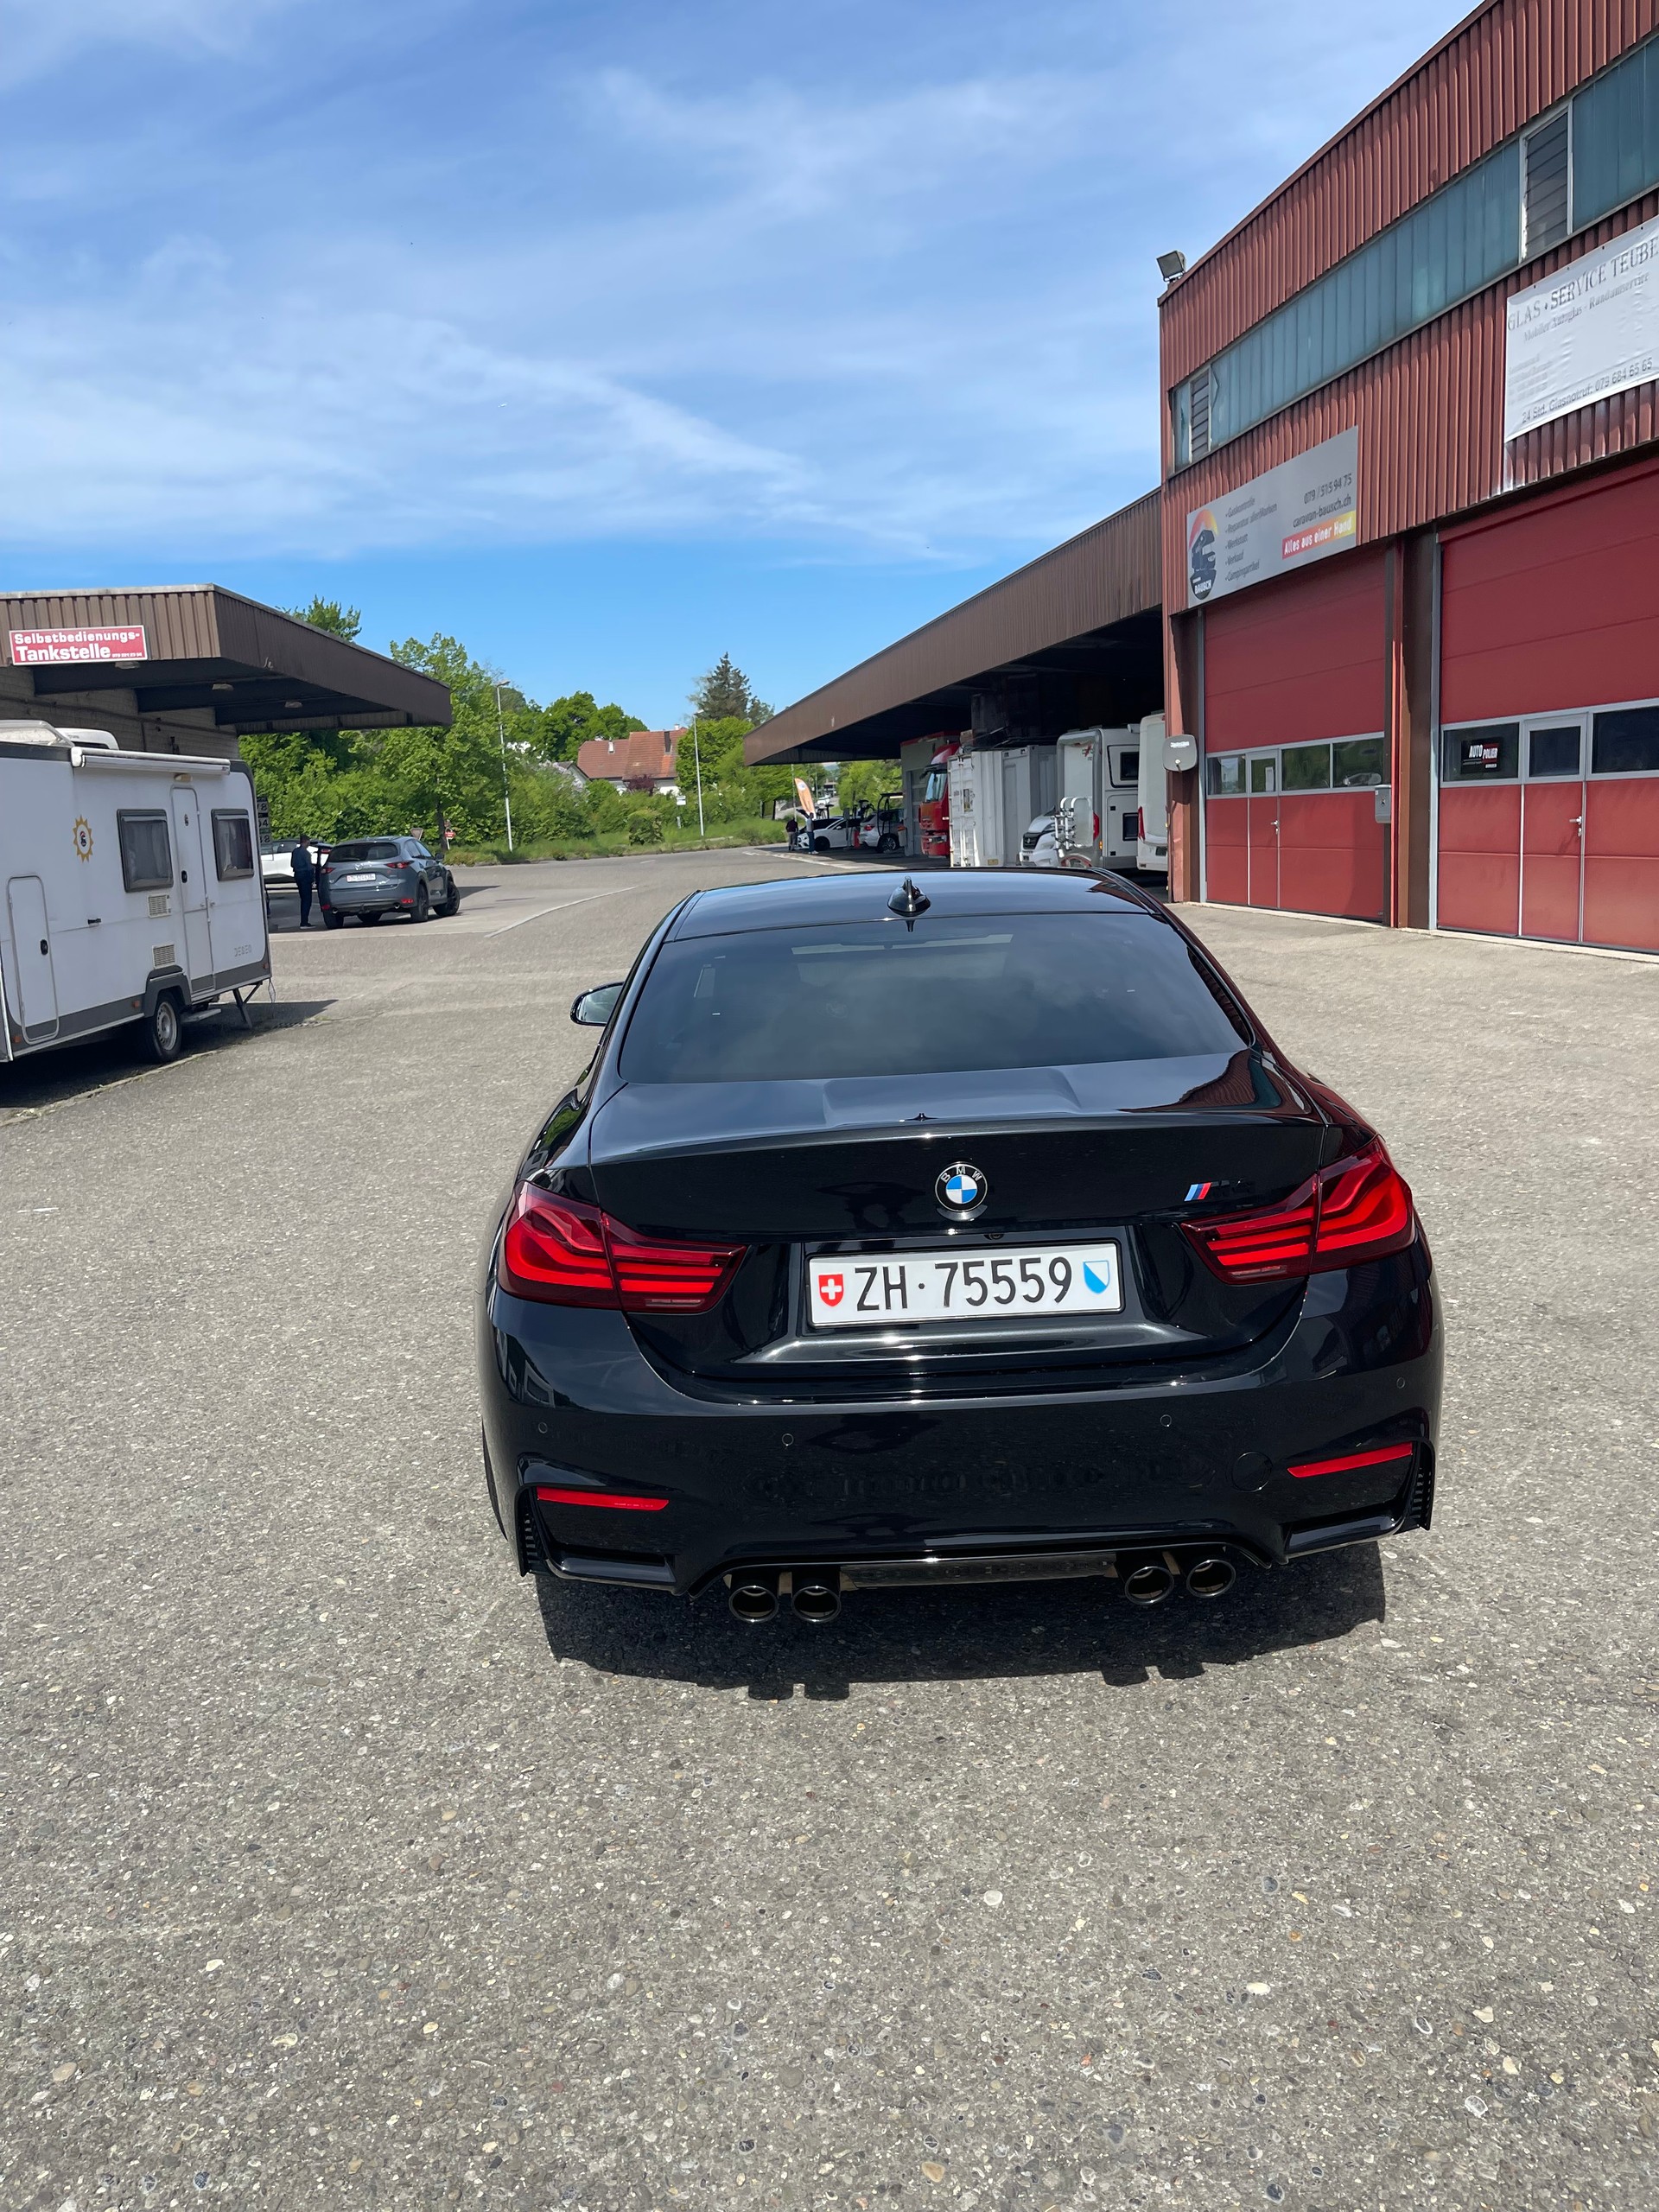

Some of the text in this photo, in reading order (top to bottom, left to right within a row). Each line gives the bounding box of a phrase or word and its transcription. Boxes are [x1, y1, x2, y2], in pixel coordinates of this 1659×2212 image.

[1508, 300, 1541, 331] GLAS
[1550, 264, 1606, 310] SERVICE
[1522, 410, 1531, 424] 24
[1611, 366, 1627, 384] 684
[1629, 362, 1640, 377] 65
[1642, 357, 1653, 372] 65
[1344, 473, 1352, 486] 75
[1284, 516, 1352, 556] Alles aus einer Hand
[14, 632, 141, 645] Selbstbedienungs-
[16, 643, 111, 663] Tankstelle
[1468, 744, 1484, 758] AUTO
[939, 1165, 984, 1183] BMW
